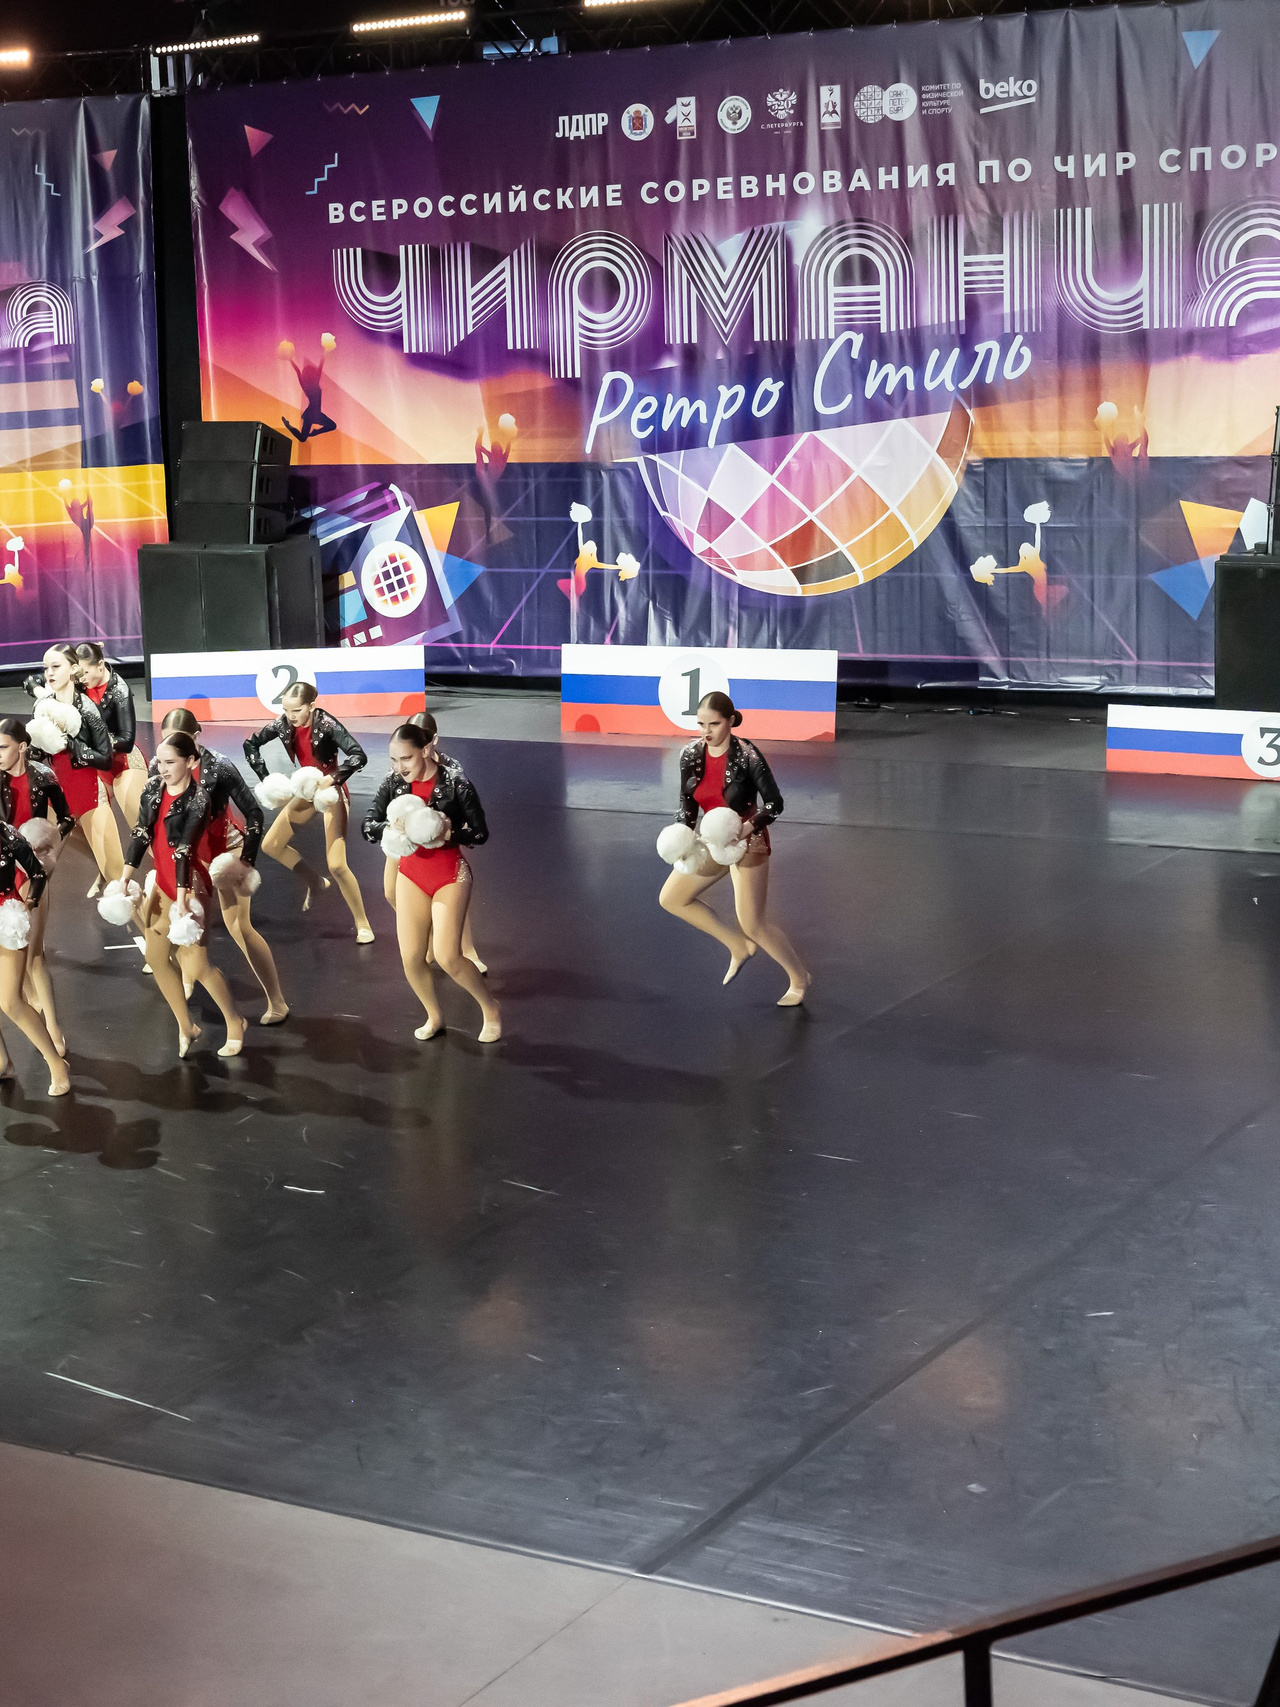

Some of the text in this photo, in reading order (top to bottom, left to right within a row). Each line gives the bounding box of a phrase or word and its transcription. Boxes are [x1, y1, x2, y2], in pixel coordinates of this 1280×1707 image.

[921, 82, 962, 91] КОМИТЕТ ПО
[979, 76, 1038, 100] beko
[555, 112, 609, 140] ЛДПР
[928, 107, 953, 115] СПОРТУ
[328, 184, 623, 224] ВСЕРОССИЙСКИЕ
[639, 162, 956, 205] СОРЕВНОВАНИЯ
[978, 157, 1032, 184] ПО
[1053, 150, 1137, 179] ЧИР
[584, 330, 1033, 455] Ретро Стиль
[271, 664, 299, 705] 2
[681, 667, 701, 716] 1
[1257, 727, 1280, 766] 3
